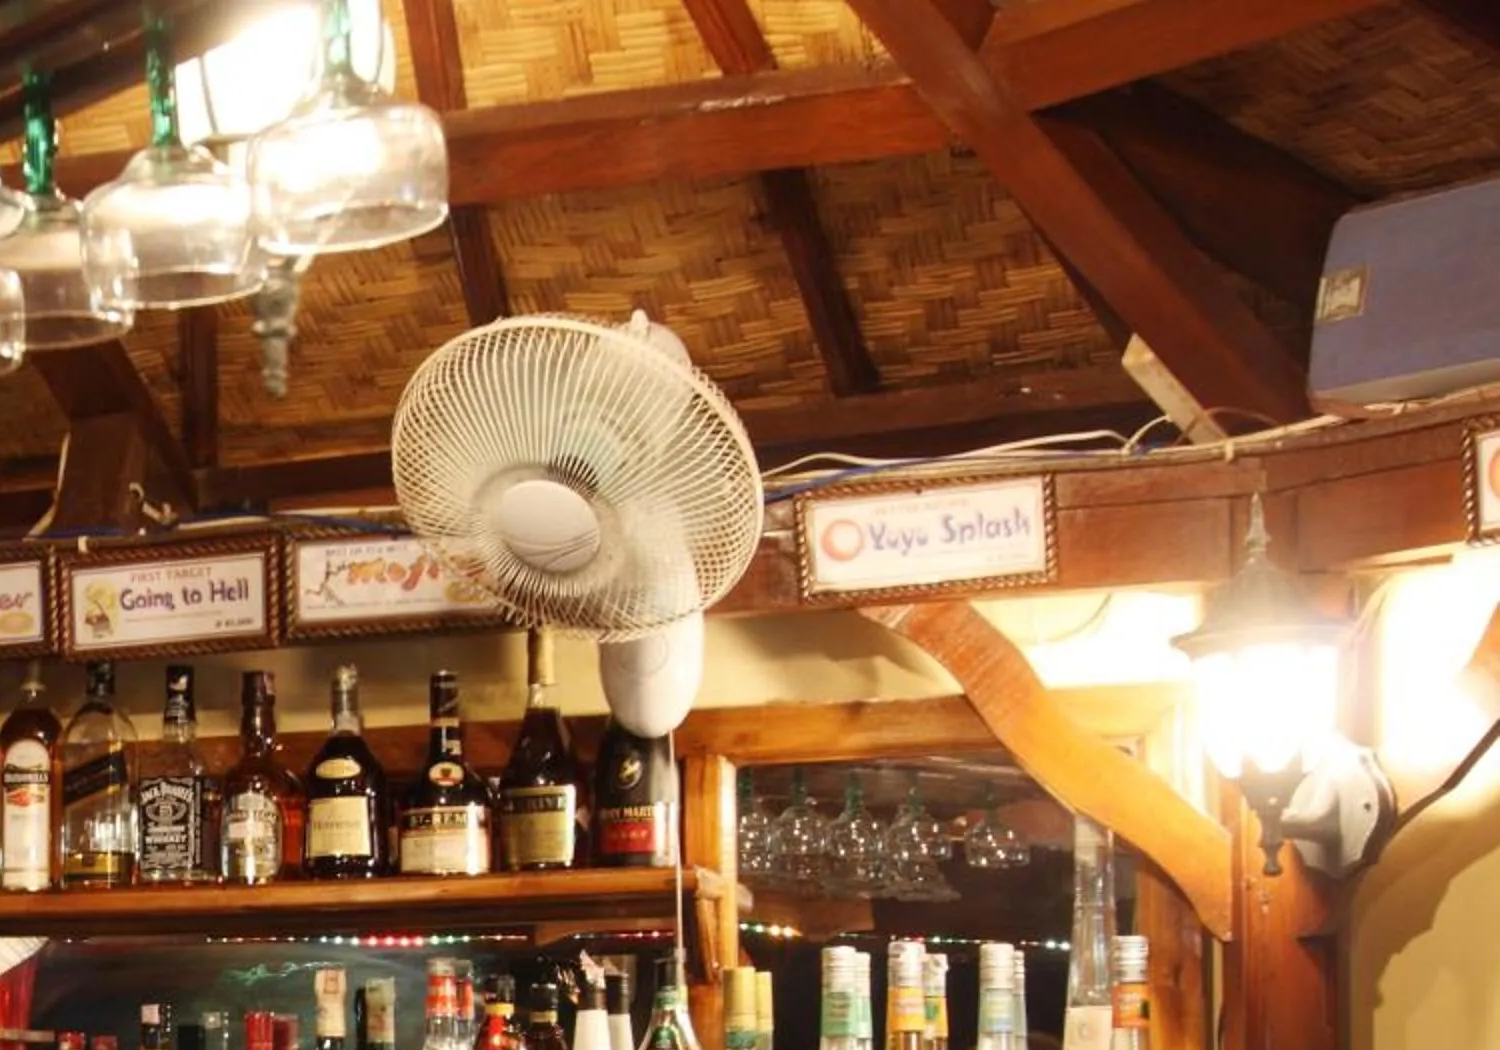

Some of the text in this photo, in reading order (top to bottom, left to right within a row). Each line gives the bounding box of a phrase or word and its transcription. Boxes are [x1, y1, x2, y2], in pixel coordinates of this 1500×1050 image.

[940, 506, 1032, 546] Splash
[119, 576, 250, 611] Going to Hell
